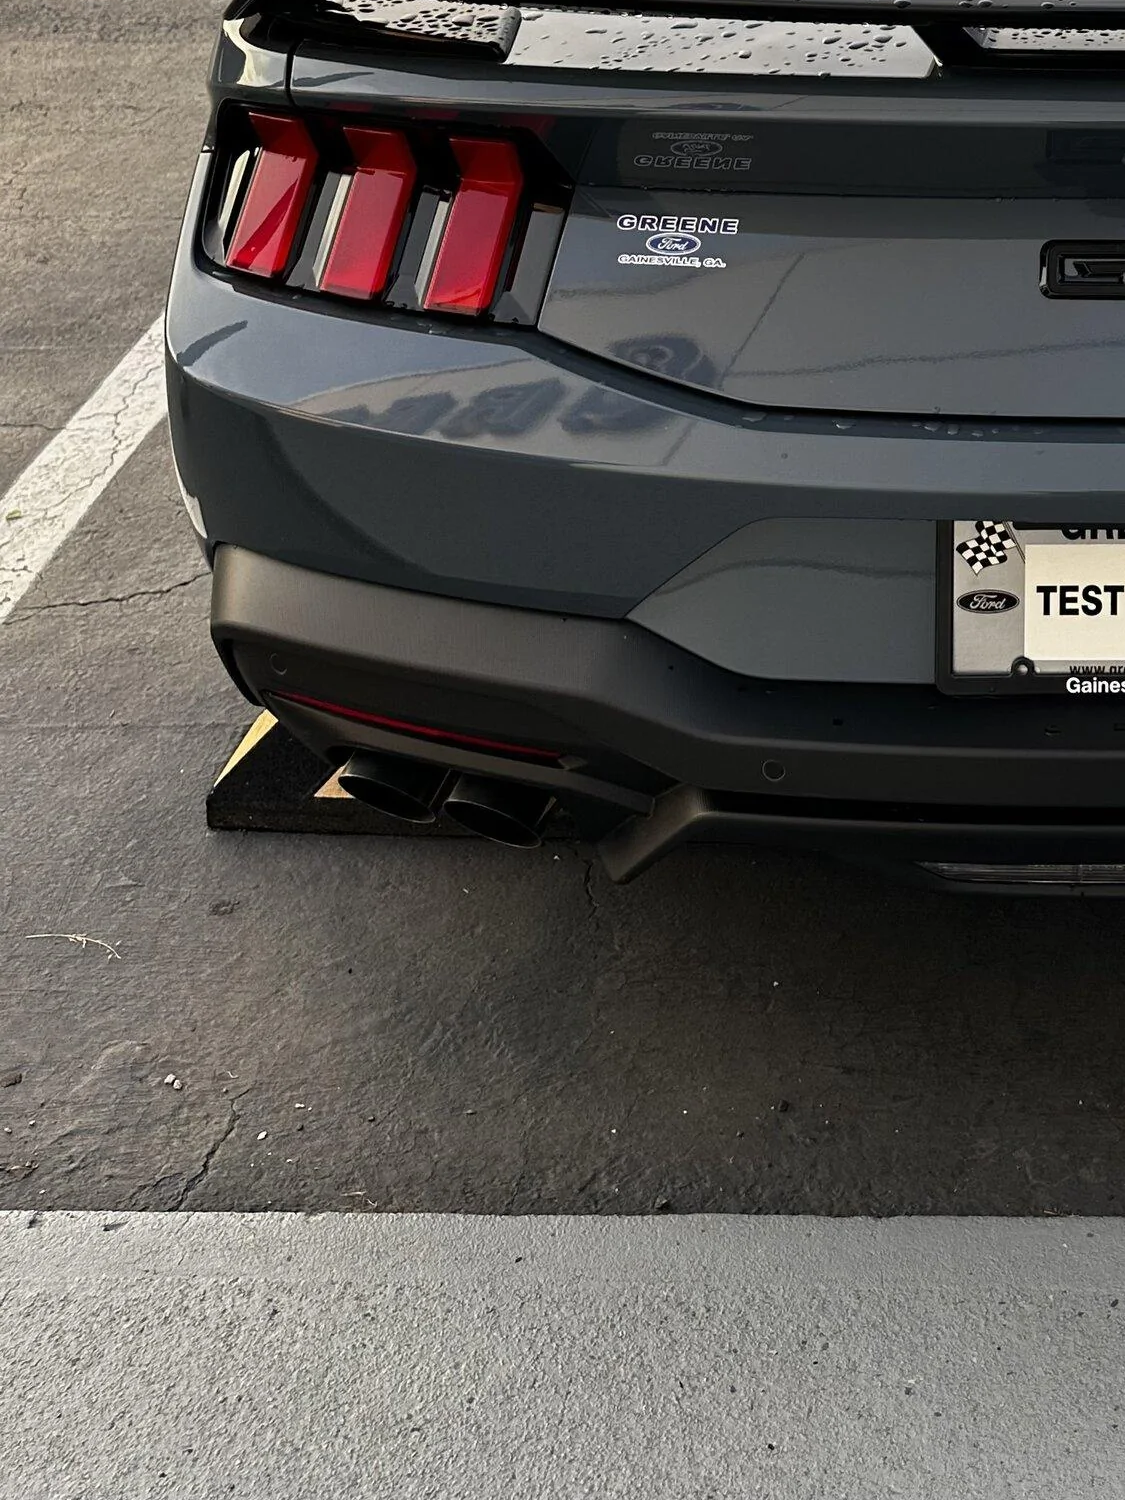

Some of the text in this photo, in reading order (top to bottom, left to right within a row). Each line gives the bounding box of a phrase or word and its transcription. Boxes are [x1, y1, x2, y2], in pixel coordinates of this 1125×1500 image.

[616, 214, 739, 235] GREENE
[657, 236, 689, 251] Ford
[618, 254, 726, 268] GAINESVILLE, GA.
[969, 592, 1006, 611] Ford
[1036, 585, 1124, 616] TEST
